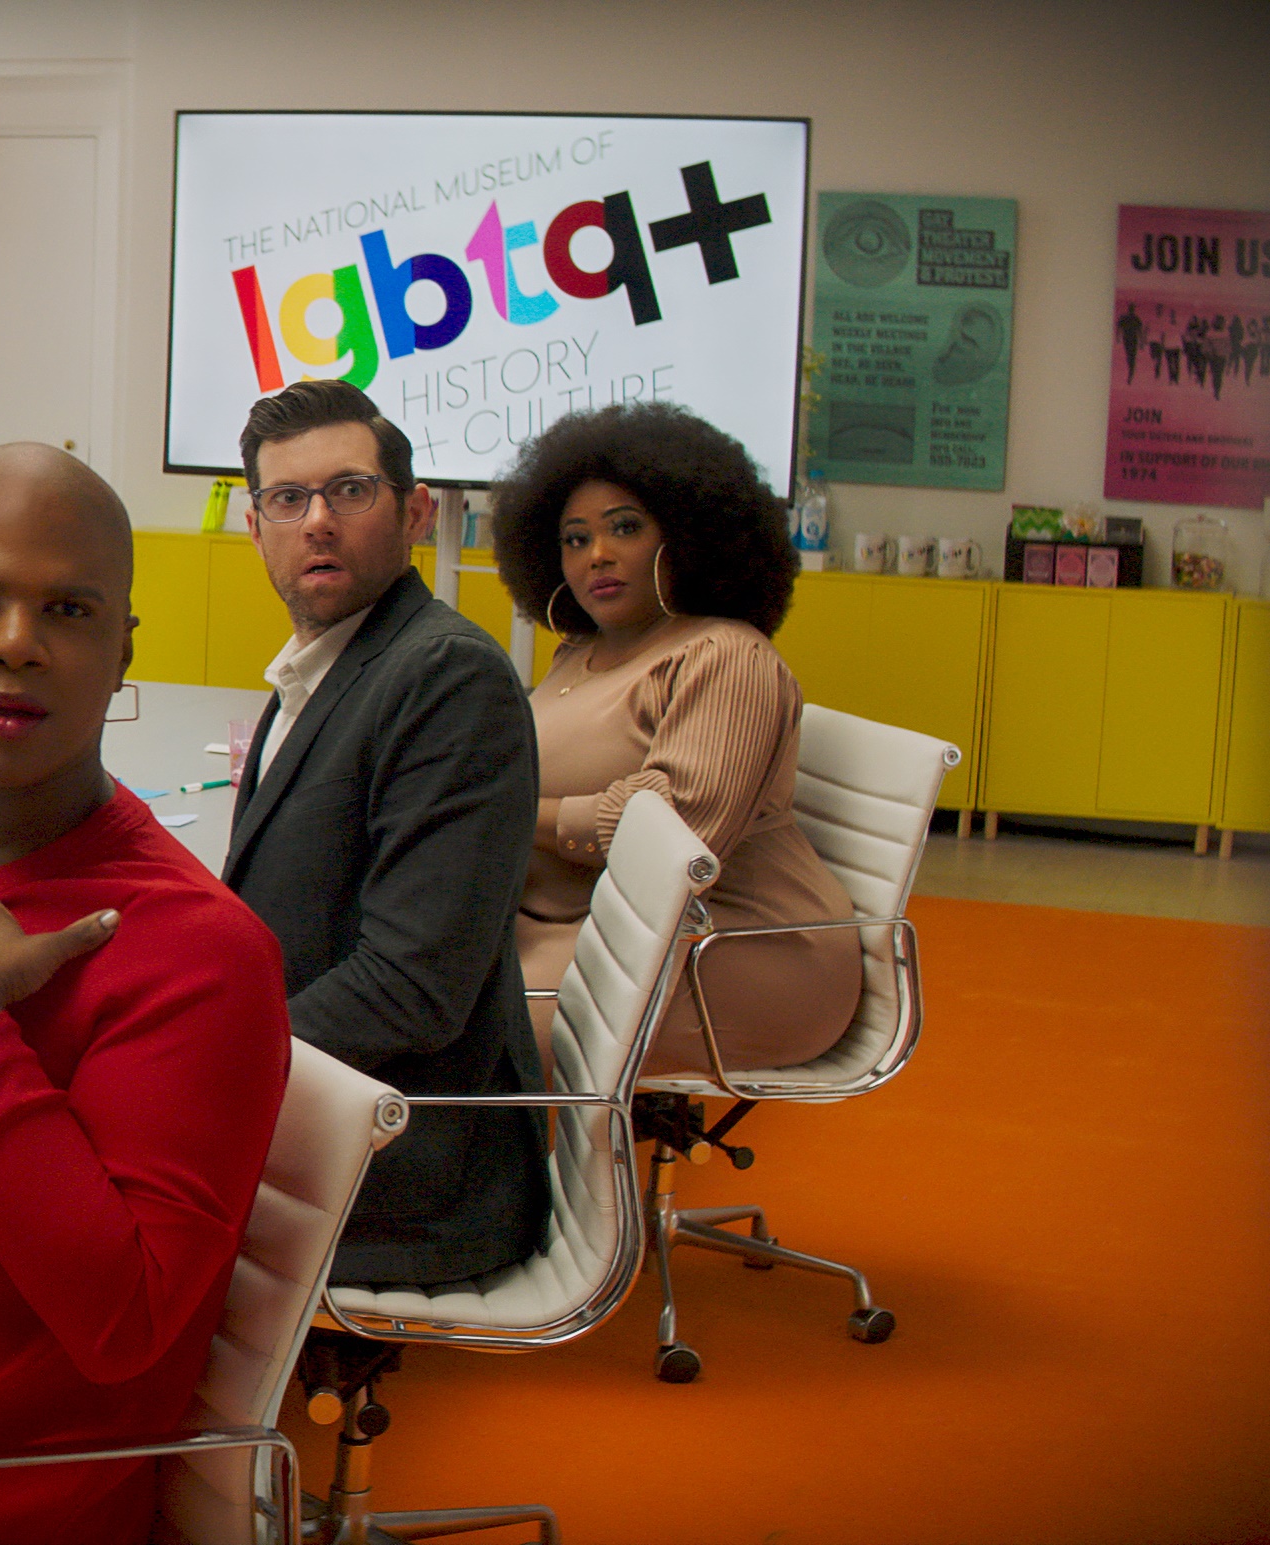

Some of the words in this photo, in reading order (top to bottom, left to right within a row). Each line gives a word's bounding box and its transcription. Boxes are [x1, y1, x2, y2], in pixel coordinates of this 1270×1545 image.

[223, 226, 274, 263] THE
[283, 186, 426, 247] NATIONAL
[433, 146, 563, 204] MUSEUM
[570, 130, 615, 167] OF
[1131, 233, 1219, 276] JOIN
[231, 160, 773, 393] lgbtq+
[401, 329, 599, 422] HISTORY
[1123, 406, 1162, 424] JOIN
[413, 425, 451, 467] +
[1120, 450, 1134, 462] IN
[1138, 451, 1197, 467] SUPPORT
